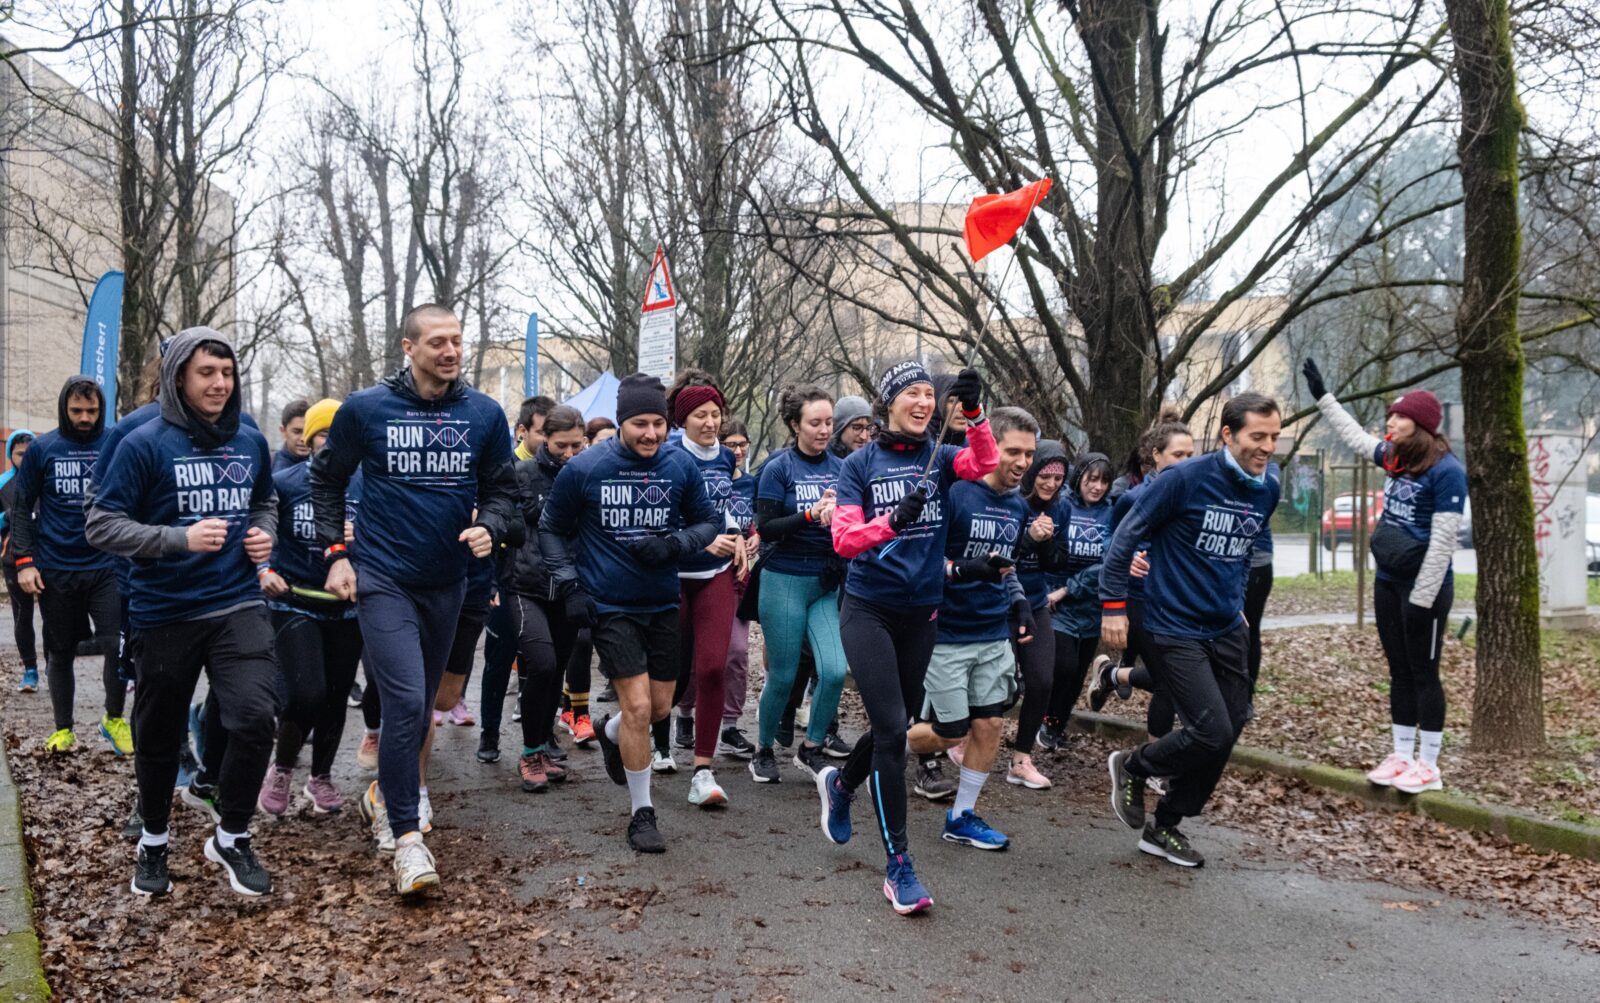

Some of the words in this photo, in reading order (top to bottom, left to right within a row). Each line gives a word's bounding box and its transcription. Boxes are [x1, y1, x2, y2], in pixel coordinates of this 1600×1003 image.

[386, 426, 424, 448] RUN
[54, 461, 81, 478] RUN
[387, 451, 422, 473] FOR
[426, 451, 472, 473] RARE
[174, 462, 215, 488] RUN
[55, 478, 80, 494] FOR
[601, 485, 632, 505] RUN
[795, 484, 821, 501] RUN
[871, 480, 906, 505] RUN
[177, 489, 214, 513] FOR
[293, 502, 315, 521] RU
[796, 501, 817, 513] FO
[874, 504, 899, 519] FO
[917, 499, 943, 523] ARE
[601, 508, 630, 527] FOR
[633, 507, 671, 527] RARE
[1202, 510, 1235, 533] RUN
[970, 518, 996, 540] RUN
[963, 541, 991, 558] FOR
[992, 543, 1015, 560] RAR
[1074, 541, 1104, 557] RARE
[1195, 532, 1227, 556] FOR
